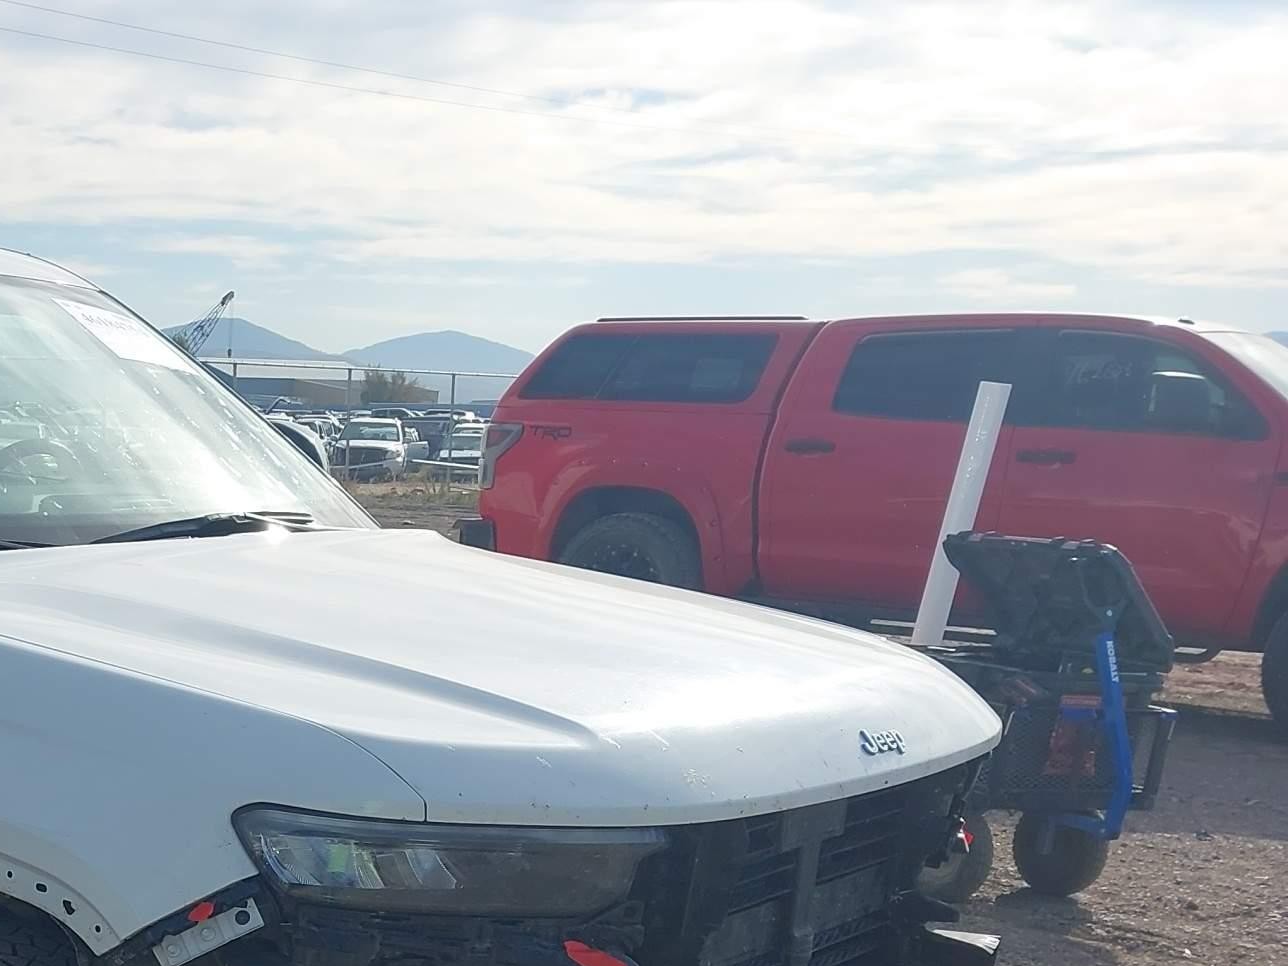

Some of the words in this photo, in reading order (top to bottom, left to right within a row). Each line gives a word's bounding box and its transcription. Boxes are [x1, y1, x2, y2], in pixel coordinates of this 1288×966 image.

[530, 424, 571, 440] TRD
[1106, 640, 1119, 682] KOBALT
[859, 729, 905, 755] Jeep
